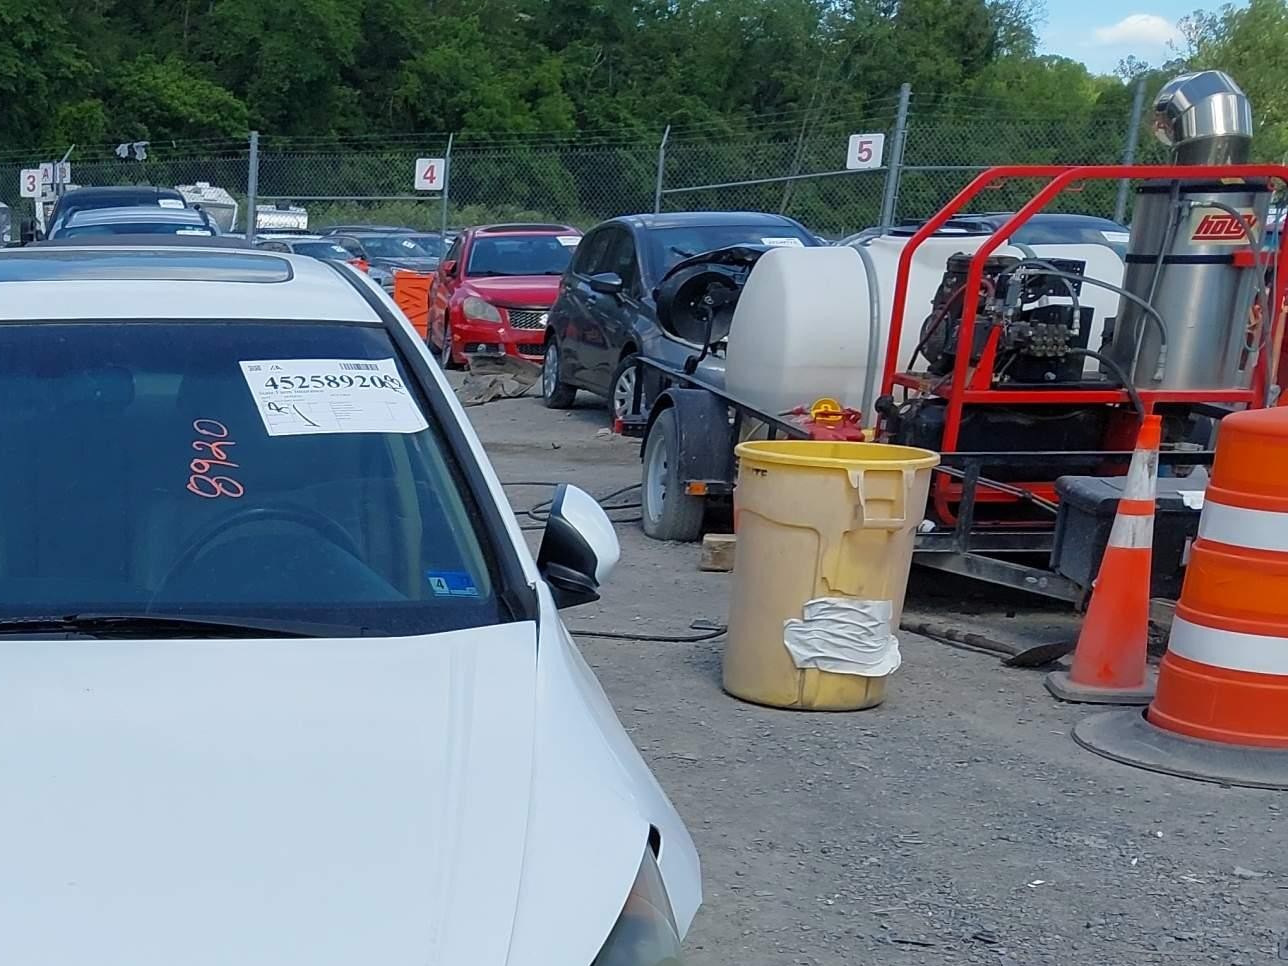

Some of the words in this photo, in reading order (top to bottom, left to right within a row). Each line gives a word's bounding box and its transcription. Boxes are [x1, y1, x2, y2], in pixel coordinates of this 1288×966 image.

[857, 141, 873, 162] 5
[27, 175, 36, 192] 3
[423, 165, 436, 184] 4
[265, 375, 384, 390] 45258920
[187, 419, 244, 497] 8920
